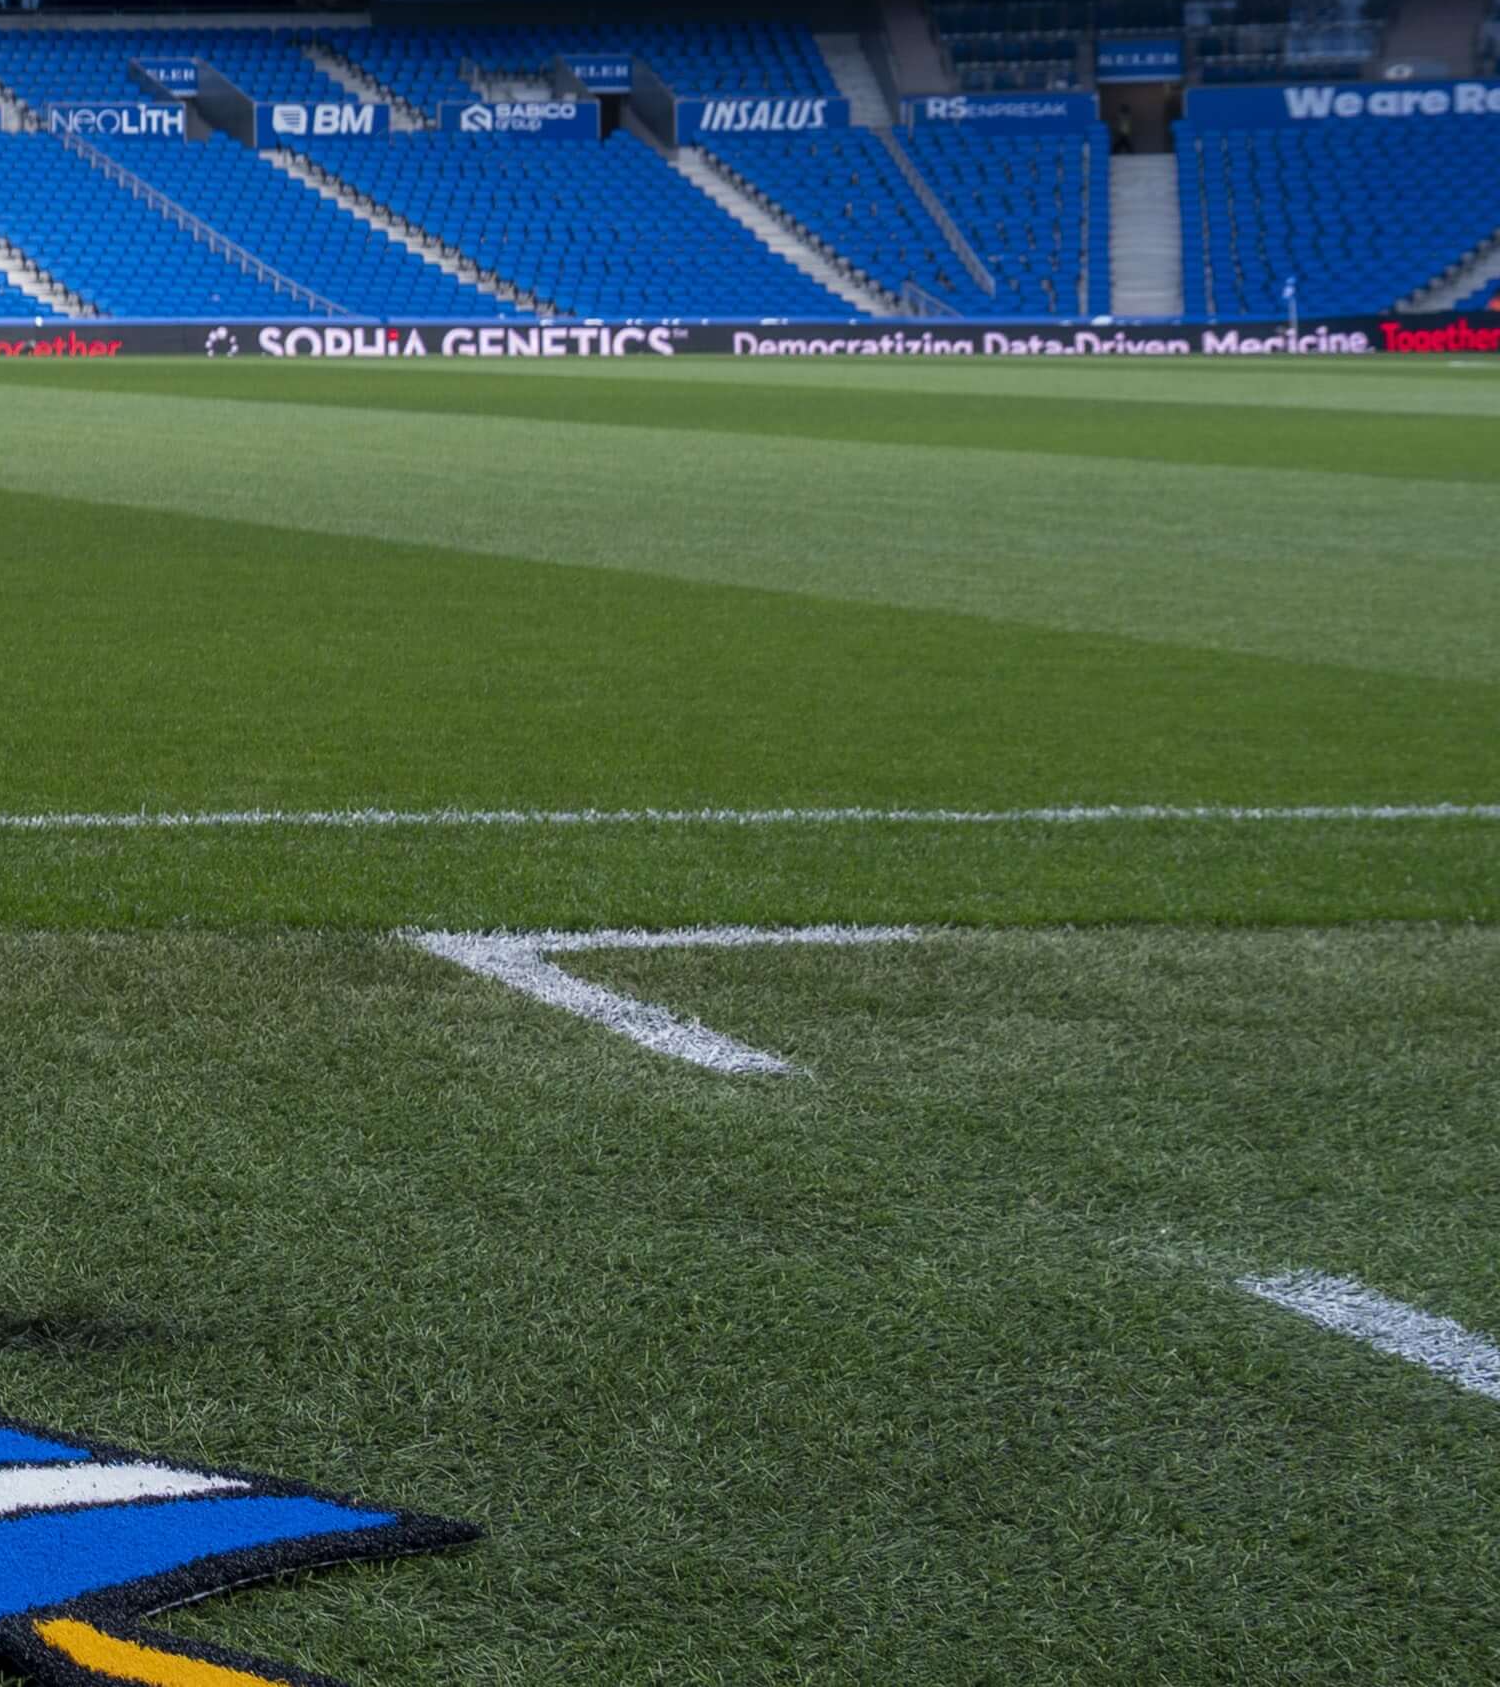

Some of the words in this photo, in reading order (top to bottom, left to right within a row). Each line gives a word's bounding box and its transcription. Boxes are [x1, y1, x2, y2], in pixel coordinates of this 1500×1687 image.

[701, 100, 827, 131] INSALUS
[1285, 85, 1364, 118] We
[1368, 89, 1449, 117] are
[313, 104, 374, 134] BM
